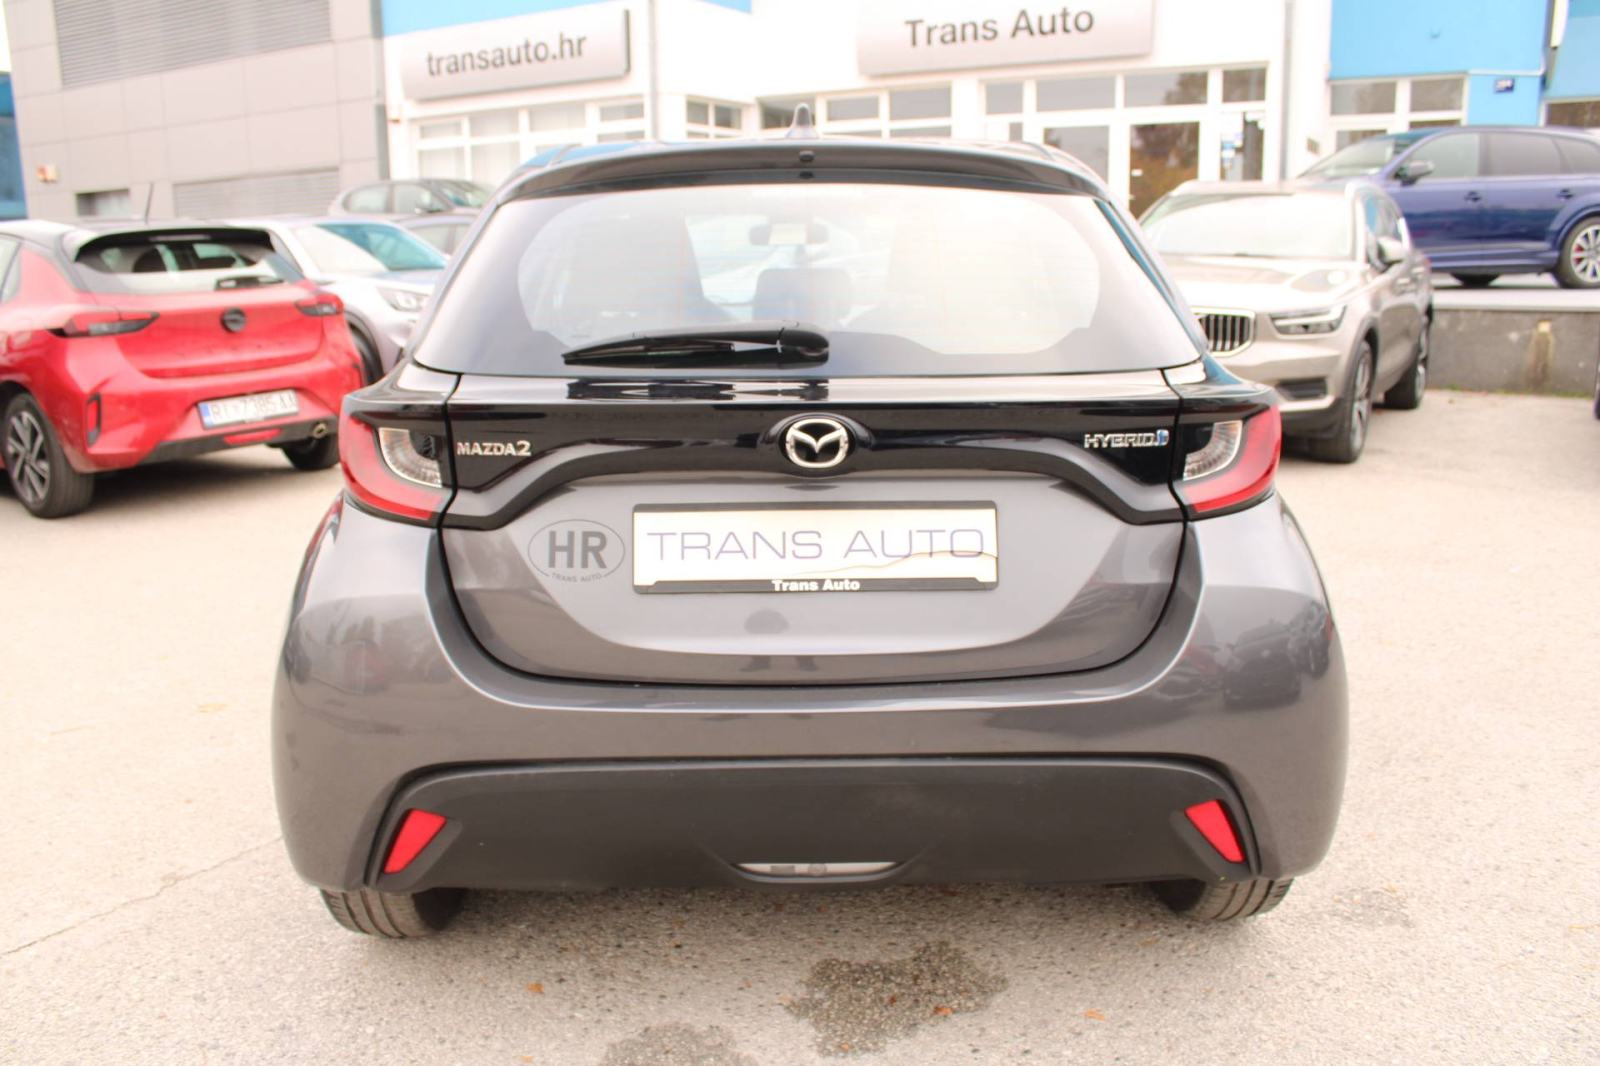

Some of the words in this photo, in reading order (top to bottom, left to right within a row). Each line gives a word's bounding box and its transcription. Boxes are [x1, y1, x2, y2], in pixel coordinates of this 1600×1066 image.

[904, 19, 998, 47] Trans
[1011, 6, 1095, 38] Auto
[426, 31, 587, 77] transauto.hr
[457, 440, 532, 456] MAZDA2
[548, 530, 607, 569] HR
[647, 530, 823, 560] TRANS
[843, 528, 985, 559] AUTO
[551, 572, 577, 582] TRANS
[580, 572, 602, 582] AUTO
[771, 579, 818, 592] Trans
[822, 578, 860, 591] Auto
